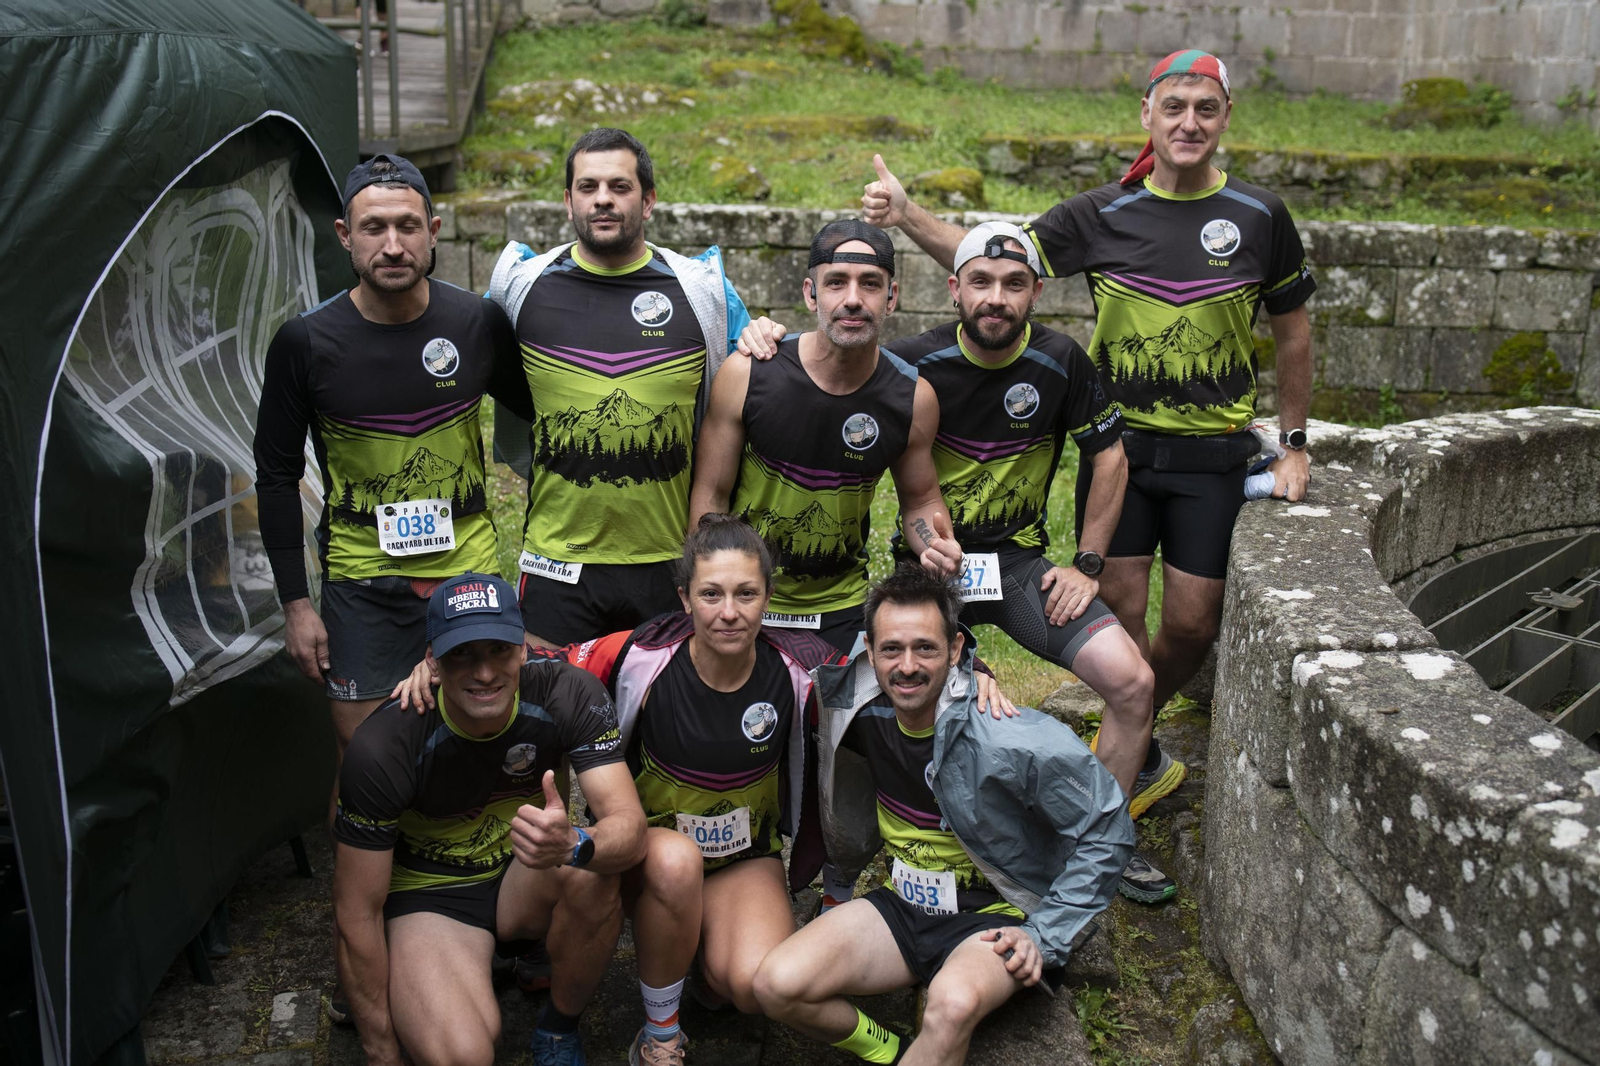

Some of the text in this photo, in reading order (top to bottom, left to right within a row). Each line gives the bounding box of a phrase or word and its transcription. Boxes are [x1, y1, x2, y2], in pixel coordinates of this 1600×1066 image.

[1208, 259, 1230, 267] CLUB
[435, 380, 456, 388] CLUB
[844, 451, 864, 461] CLUB
[393, 504, 439, 517] SPAIN
[397, 513, 436, 538] 038
[386, 535, 451, 551] BACKYARD ULTRA
[522, 558, 548, 571] BACKYARD
[547, 564, 573, 577] ULTRA
[454, 583, 486, 595] TRAIL
[973, 588, 999, 596] ULTRA
[447, 590, 487, 606] RIBEIRA
[455, 598, 488, 612] SACRA
[750, 745, 769, 754] CLUB
[1066, 776, 1094, 801] SALOM
[691, 815, 736, 827] SPAIN
[695, 824, 734, 843] 046
[721, 837, 748, 852] ULTRA
[899, 869, 941, 885] SPAIN
[903, 879, 939, 906] 053
